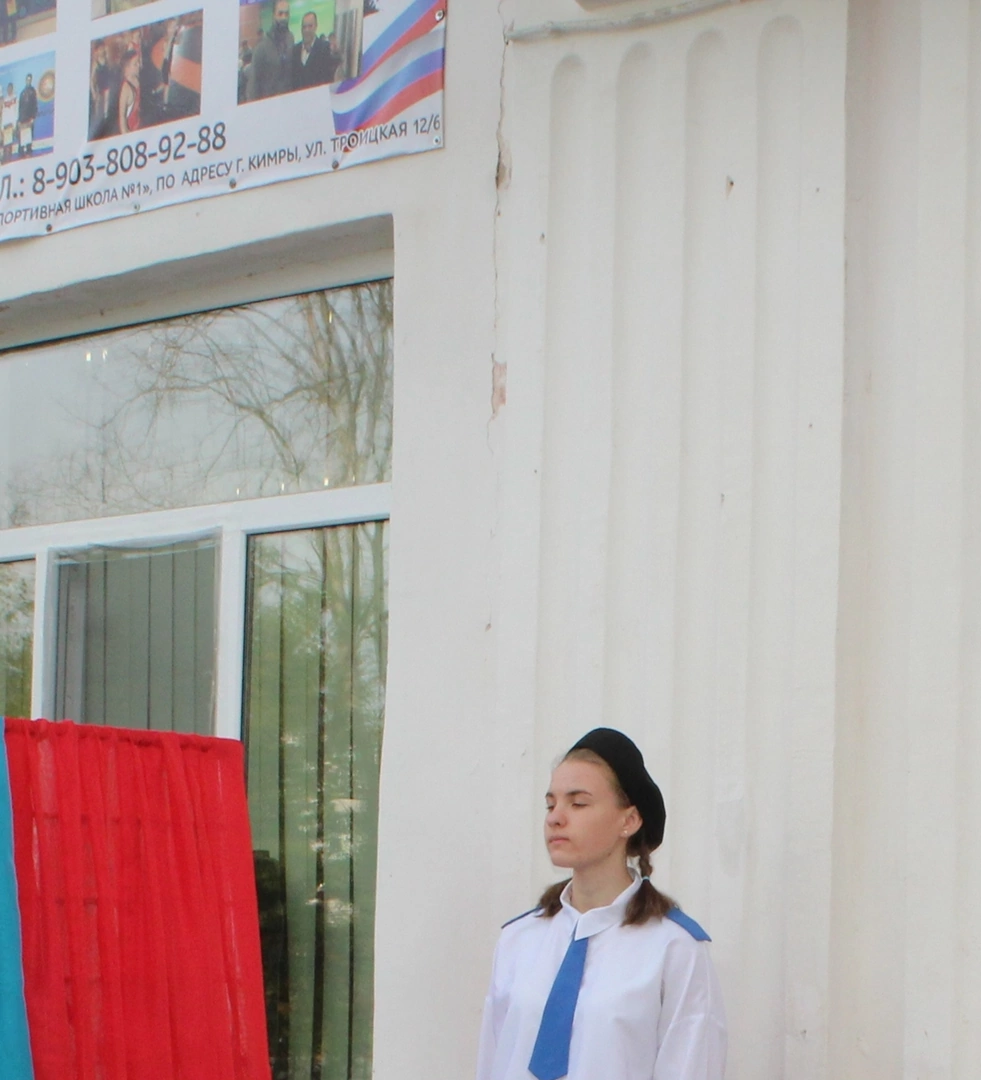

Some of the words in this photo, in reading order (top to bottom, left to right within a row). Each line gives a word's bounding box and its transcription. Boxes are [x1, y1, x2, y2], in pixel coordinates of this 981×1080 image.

[31, 122, 228, 196] 8-903-808-92-88
[74, 188, 119, 211] ШКОЛА
[156, 173, 176, 192] ПО
[181, 160, 233, 187] АДРЕСУ
[236, 158, 245, 173] Г.
[248, 146, 302, 171] КИМРЫ,
[305, 141, 327, 158] УЛ.
[330, 121, 408, 152] ТРОИЦКАЯ
[413, 113, 441, 134] 12/6
